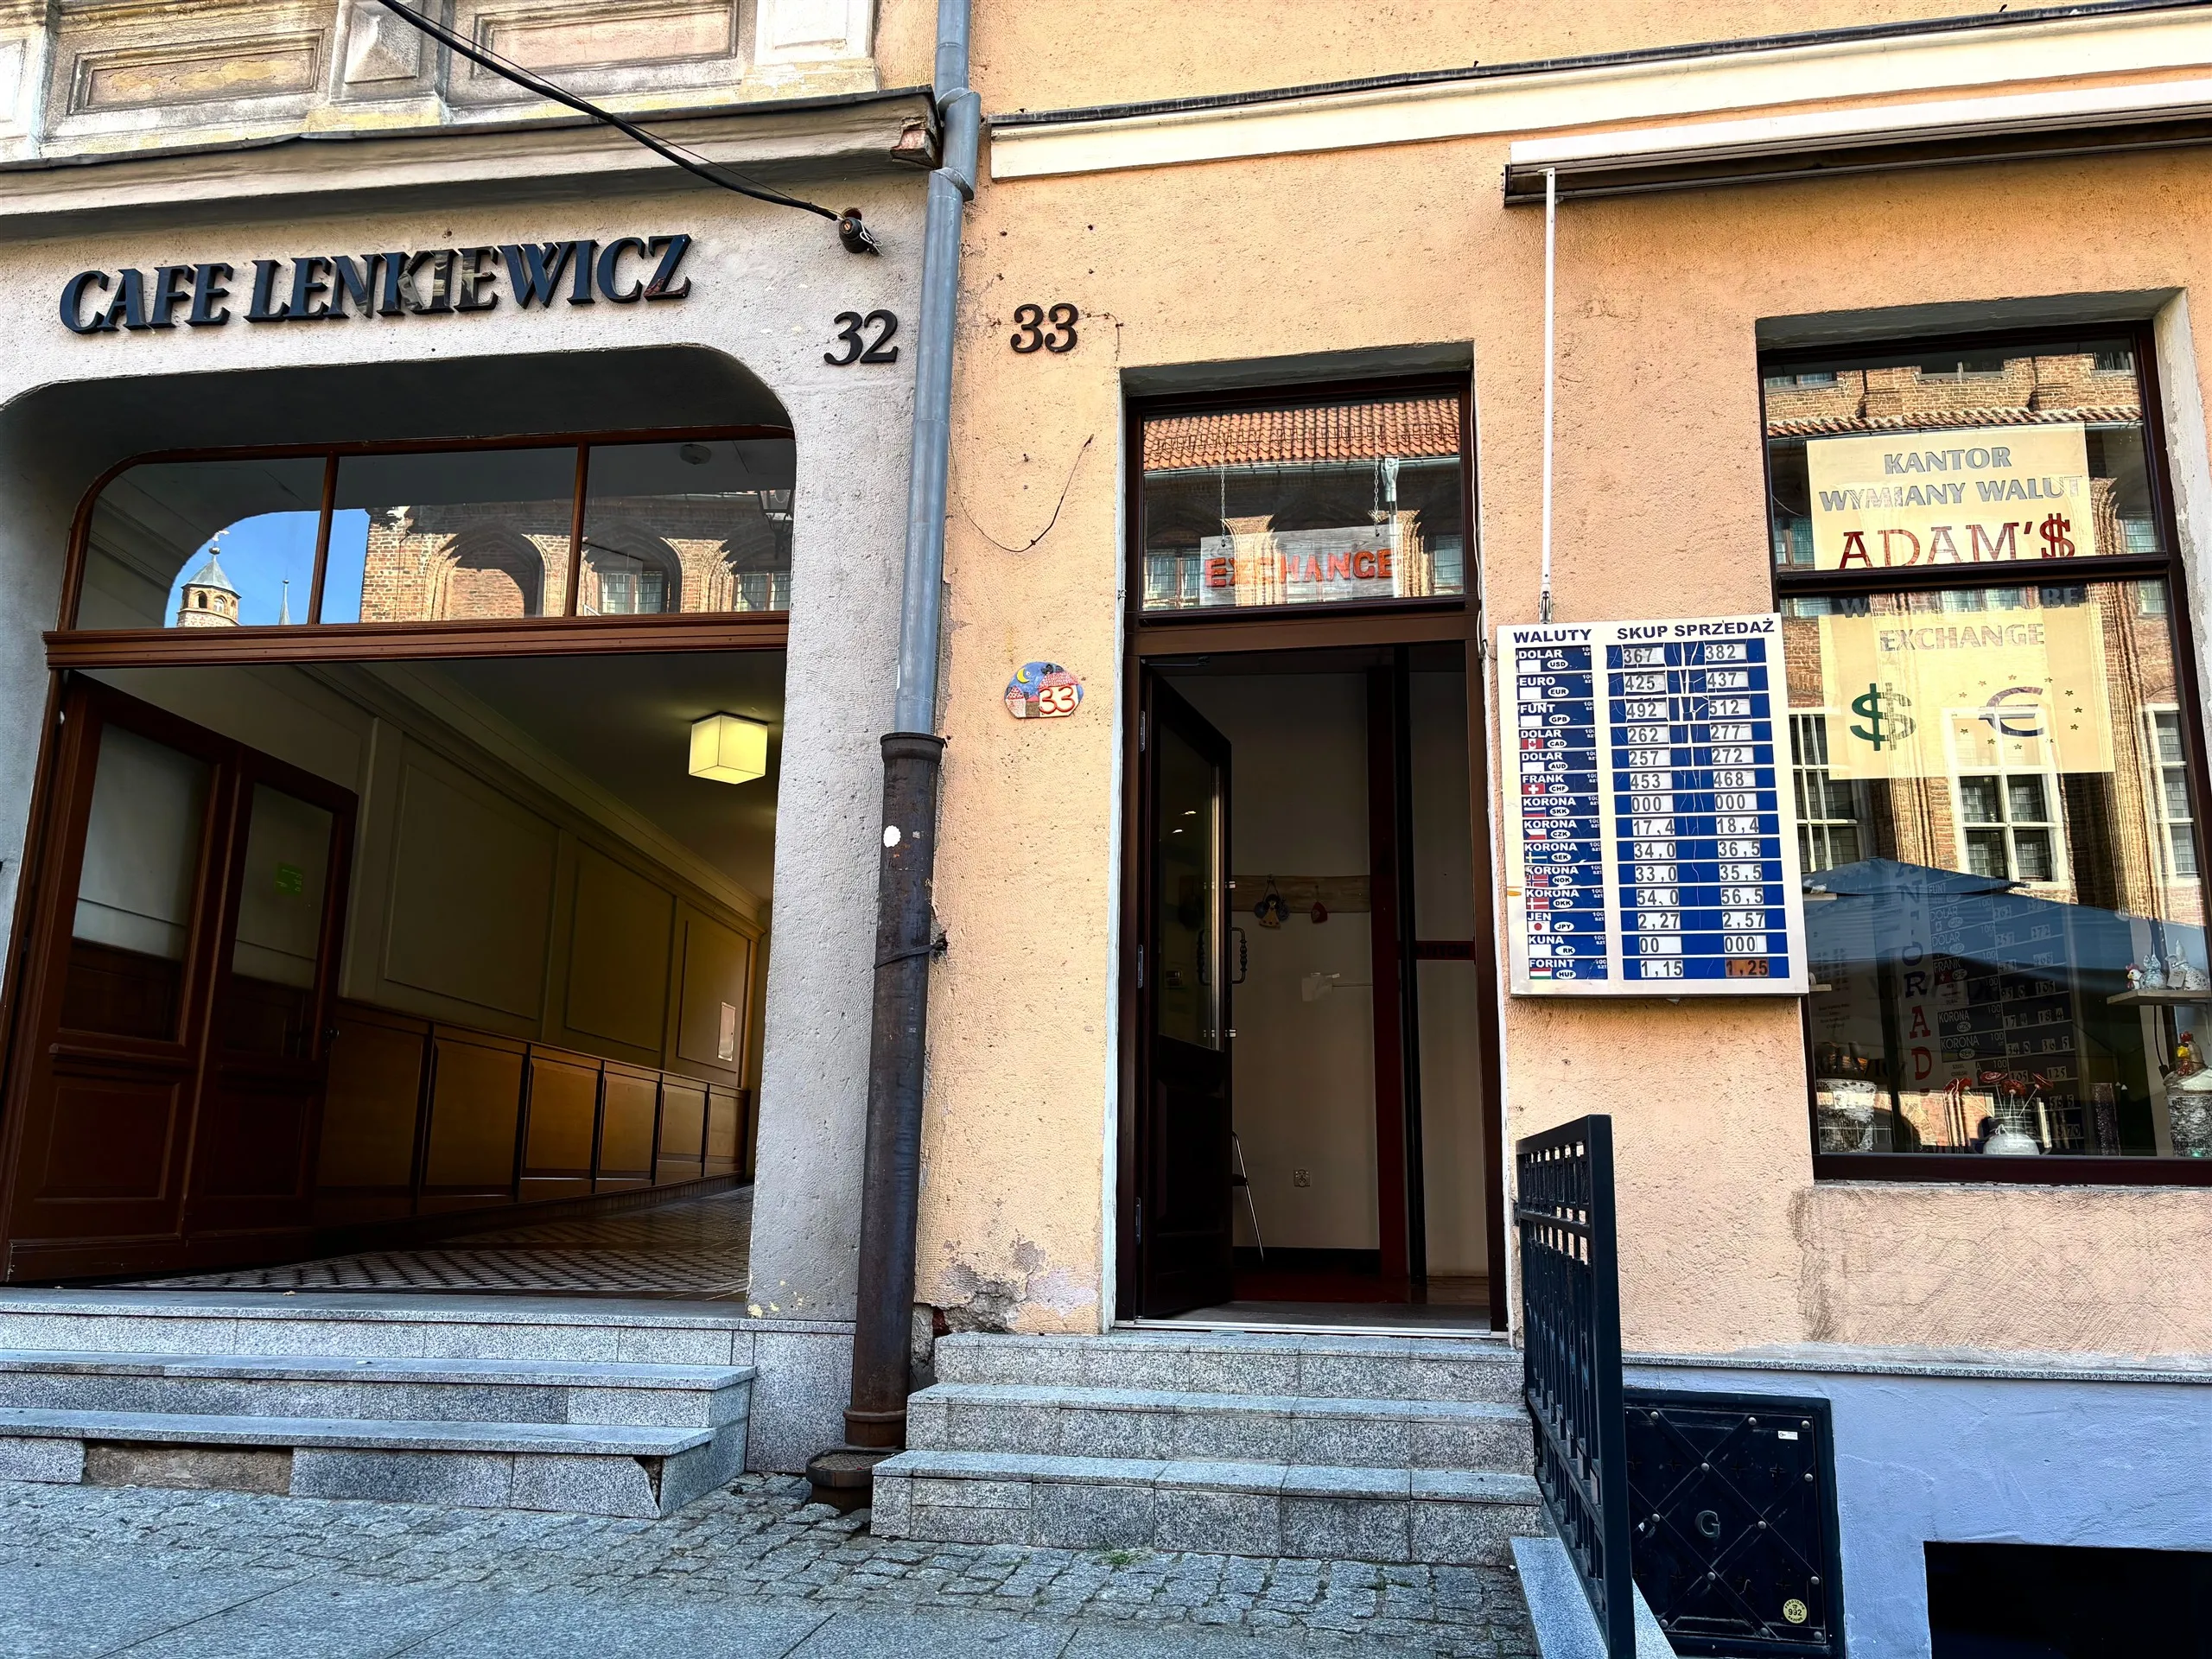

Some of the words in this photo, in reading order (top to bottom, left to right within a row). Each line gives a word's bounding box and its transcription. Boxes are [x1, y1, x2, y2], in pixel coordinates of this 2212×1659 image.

[59, 263, 235, 335] CAFE
[243, 233, 693, 325] LENKIEWICZ
[1009, 302, 1079, 353] 33
[823, 309, 899, 366] 32
[1885, 447, 2012, 474] KANTOR
[1819, 482, 1966, 512] WYMIANY
[1975, 475, 2082, 502] WALUT
[1513, 628, 1592, 644] WALUTY
[1617, 625, 1669, 640] SKUP
[1674, 618, 1775, 637] SPRZEDAŻ
[1879, 623, 2045, 652] EXCHANGE
[1518, 649, 1563, 659] DOLAR
[1624, 648, 1654, 664] 367
[1705, 644, 1736, 660] 382
[1519, 677, 1556, 686] EURO
[1625, 675, 1655, 690] 425
[1707, 671, 1737, 688] 437
[1038, 683, 1076, 715] 33
[1521, 704, 1556, 714] FUNT
[1626, 702, 1657, 718] 492
[1709, 699, 1739, 715] 512
[1521, 729, 1562, 738] DOLAR
[1628, 728, 1658, 743] 262
[1711, 724, 1740, 741] 277
[1522, 752, 1563, 761] DOLAR
[1629, 750, 1659, 766] 257
[1712, 747, 1743, 763] 272
[1522, 774, 1565, 783] FRANK
[1630, 773, 1661, 789] 453
[1713, 772, 1744, 786] 468
[1523, 797, 1576, 806] KORONA
[1631, 796, 1662, 812] 000
[1715, 794, 1745, 810] 000
[1524, 819, 1577, 829] KORONA
[1524, 842, 1578, 851] KORONA
[1526, 866, 1579, 874] KORONA
[1526, 889, 1580, 898] KORONA
[1527, 912, 1552, 921] JEN
[1528, 936, 1565, 944] KUNA
[1725, 936, 1756, 952] 000
[1932, 931, 1961, 947] DOLAR
[1529, 959, 1575, 968] FORINT
[1934, 957, 1961, 972] FRANK
[1938, 1010, 1970, 1023] KORONA
[1941, 1035, 1980, 1050] KORONA
[1694, 1510, 1721, 1539] G
[1788, 1608, 1802, 1617] 992
